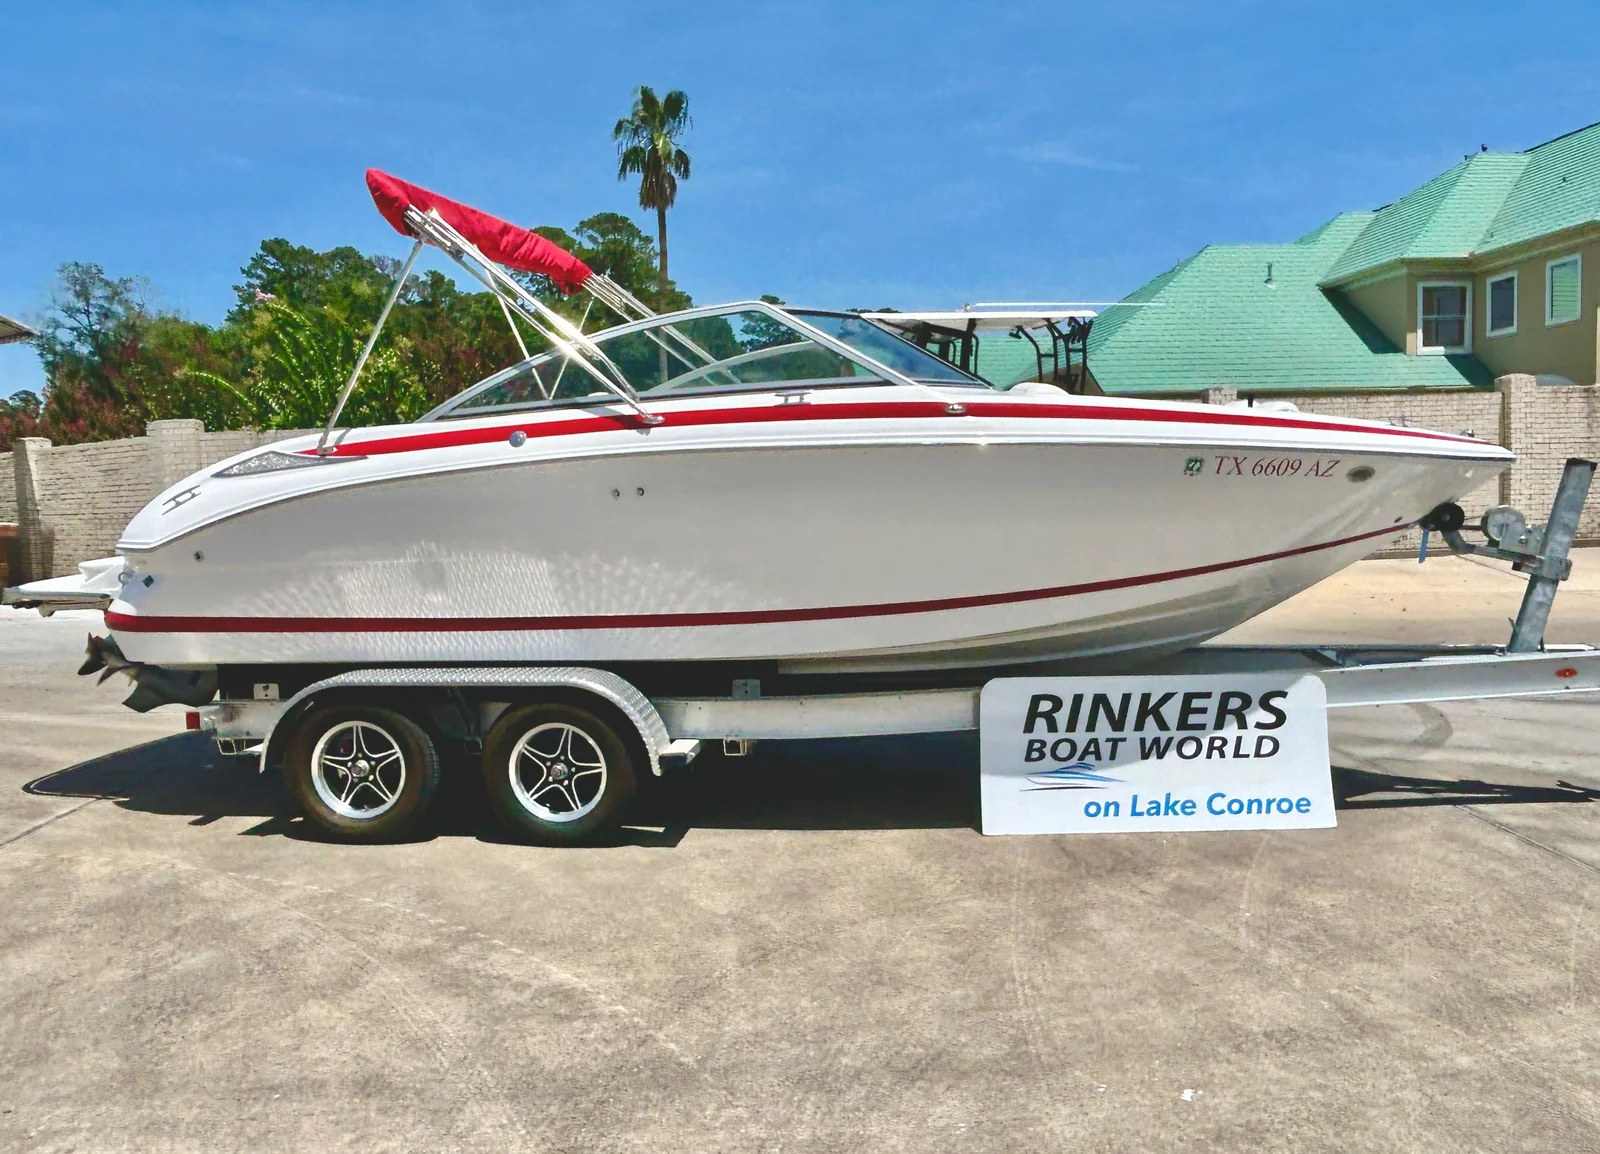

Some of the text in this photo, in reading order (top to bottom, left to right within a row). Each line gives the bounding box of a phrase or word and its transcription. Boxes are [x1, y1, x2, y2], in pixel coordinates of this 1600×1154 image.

[1214, 455, 1248, 476] TX
[1251, 456, 1303, 477] 6609
[1304, 459, 1341, 478] AZ
[1023, 690, 1289, 734] RINKERS
[1024, 735, 1280, 762] BOAT WORLD
[1084, 792, 1312, 817] on Lake Conroe
